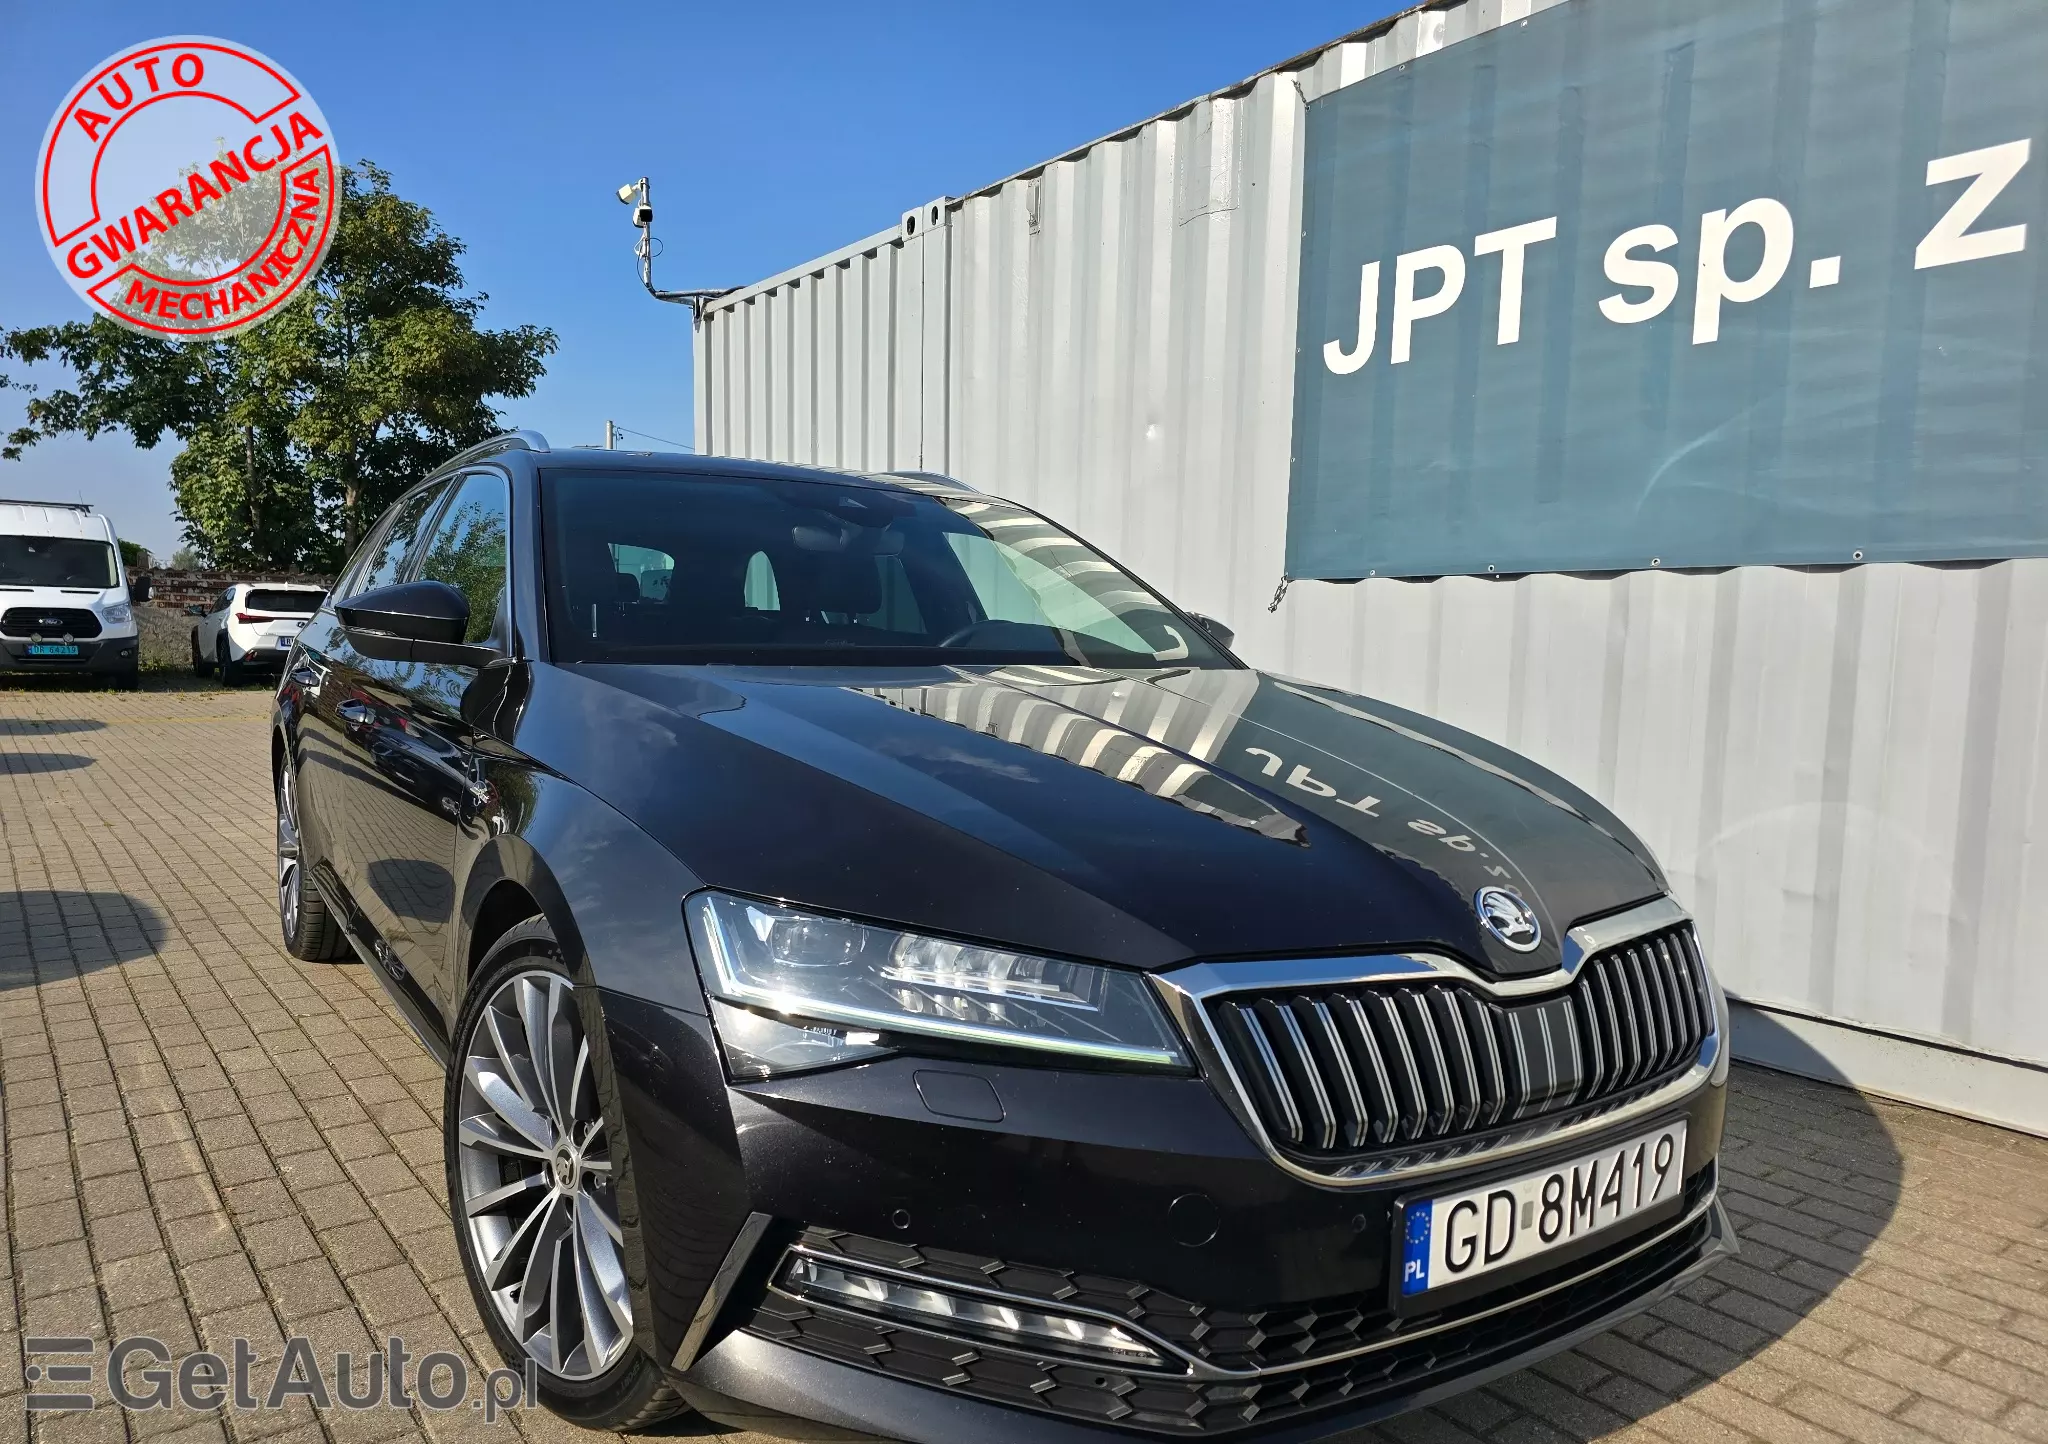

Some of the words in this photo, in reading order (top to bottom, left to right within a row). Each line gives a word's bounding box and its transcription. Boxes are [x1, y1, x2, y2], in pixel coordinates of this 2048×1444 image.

[1323, 216, 1557, 375] JPT
[1598, 197, 1841, 345] sp.
[1404, 1260, 1425, 1283] PL
[1444, 1189, 1516, 1273] GD
[1538, 1133, 1675, 1244] 8M419
